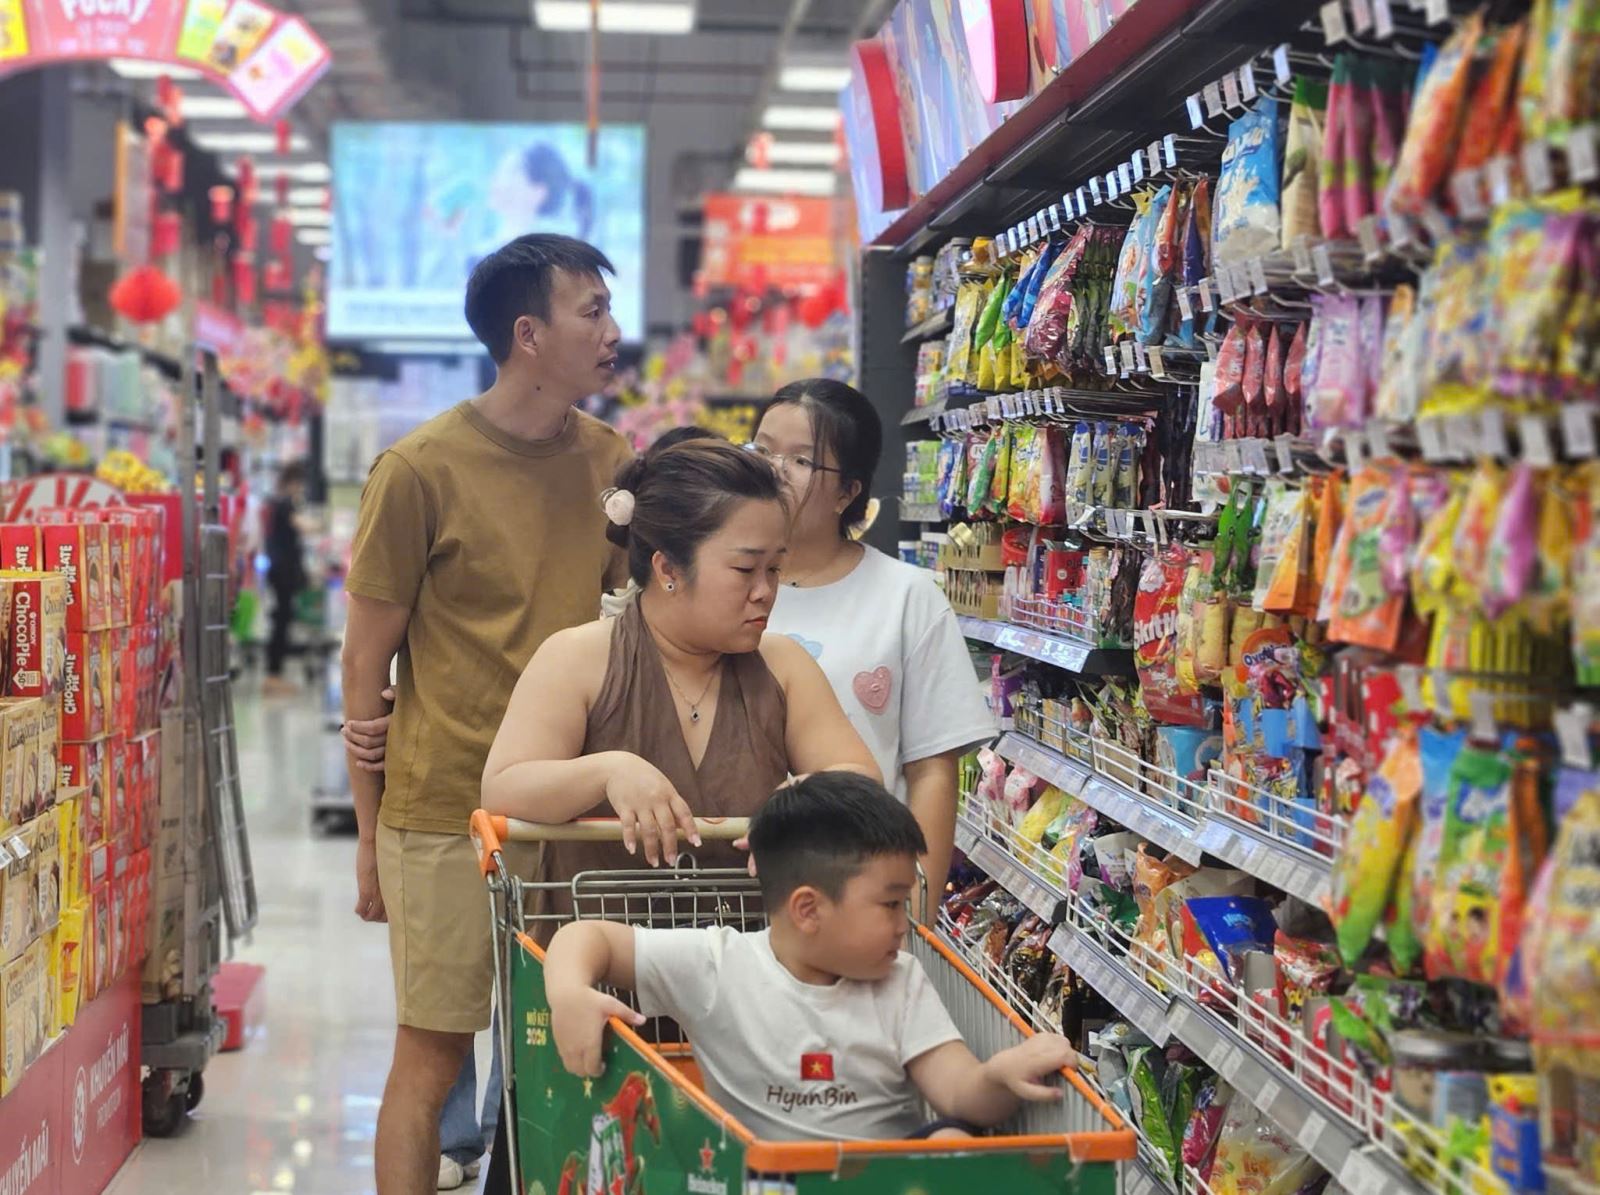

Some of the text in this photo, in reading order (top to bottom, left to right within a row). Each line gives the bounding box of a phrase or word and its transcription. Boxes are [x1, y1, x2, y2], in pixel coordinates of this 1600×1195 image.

[59, 545, 75, 605] CHOLATE
[15, 591, 31, 667] ChocoPie
[1134, 610, 1176, 650] Skittl
[766, 1084, 859, 1113] HyunBin
